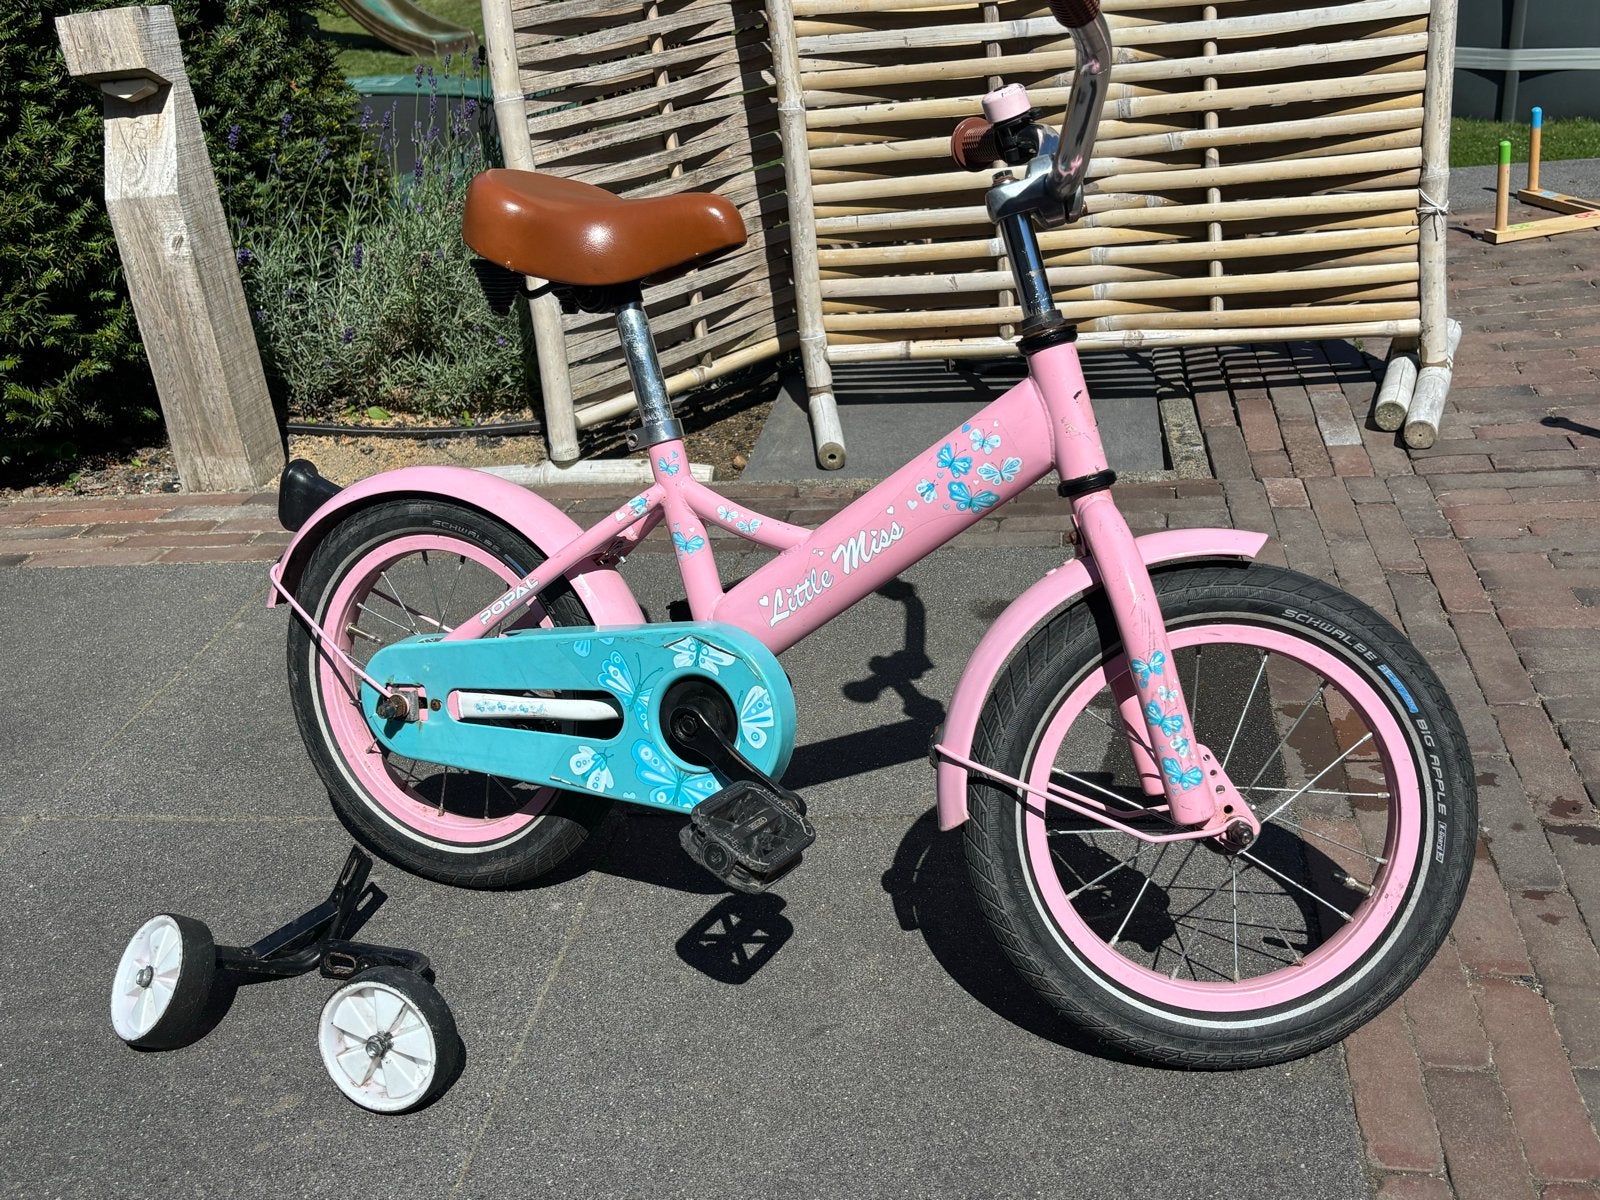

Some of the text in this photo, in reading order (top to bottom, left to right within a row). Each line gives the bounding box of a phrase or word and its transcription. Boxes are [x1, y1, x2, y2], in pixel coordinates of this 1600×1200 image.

[432, 520, 501, 552] SCHWALBE
[480, 577, 539, 625] POPAL
[769, 521, 904, 627] Little Miss
[1281, 608, 1378, 662] SCHWALBE
[1416, 718, 1447, 816] BIG APPLE
